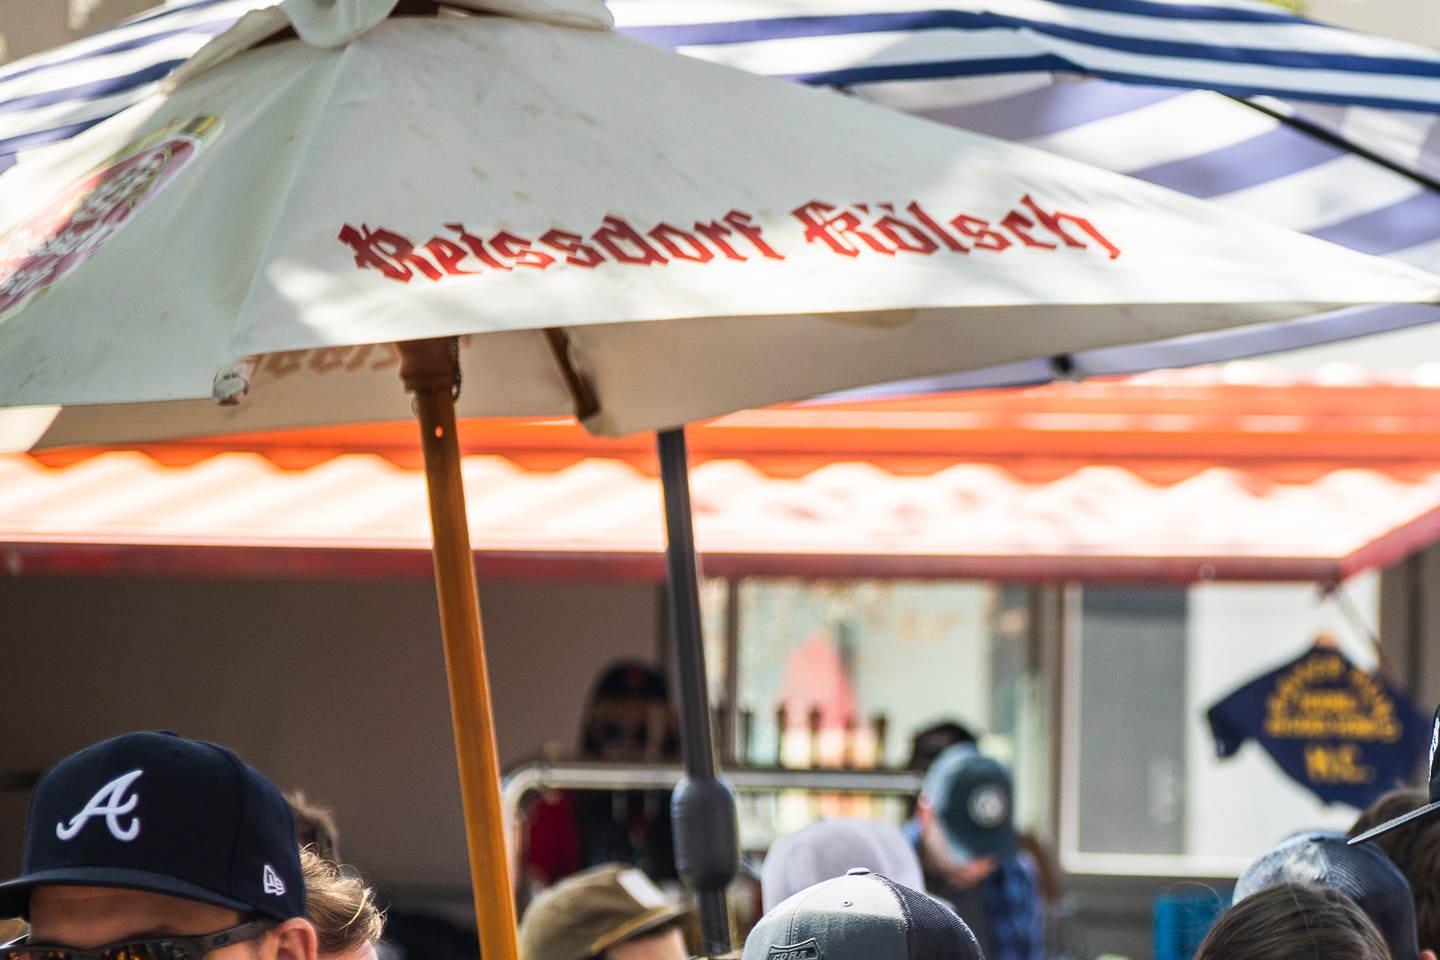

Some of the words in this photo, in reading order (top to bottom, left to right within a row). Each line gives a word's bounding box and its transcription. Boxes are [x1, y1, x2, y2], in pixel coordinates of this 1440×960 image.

[338, 208, 785, 284] Reissdorf
[791, 194, 1121, 260] Kölsch
[56, 769, 144, 842] A
